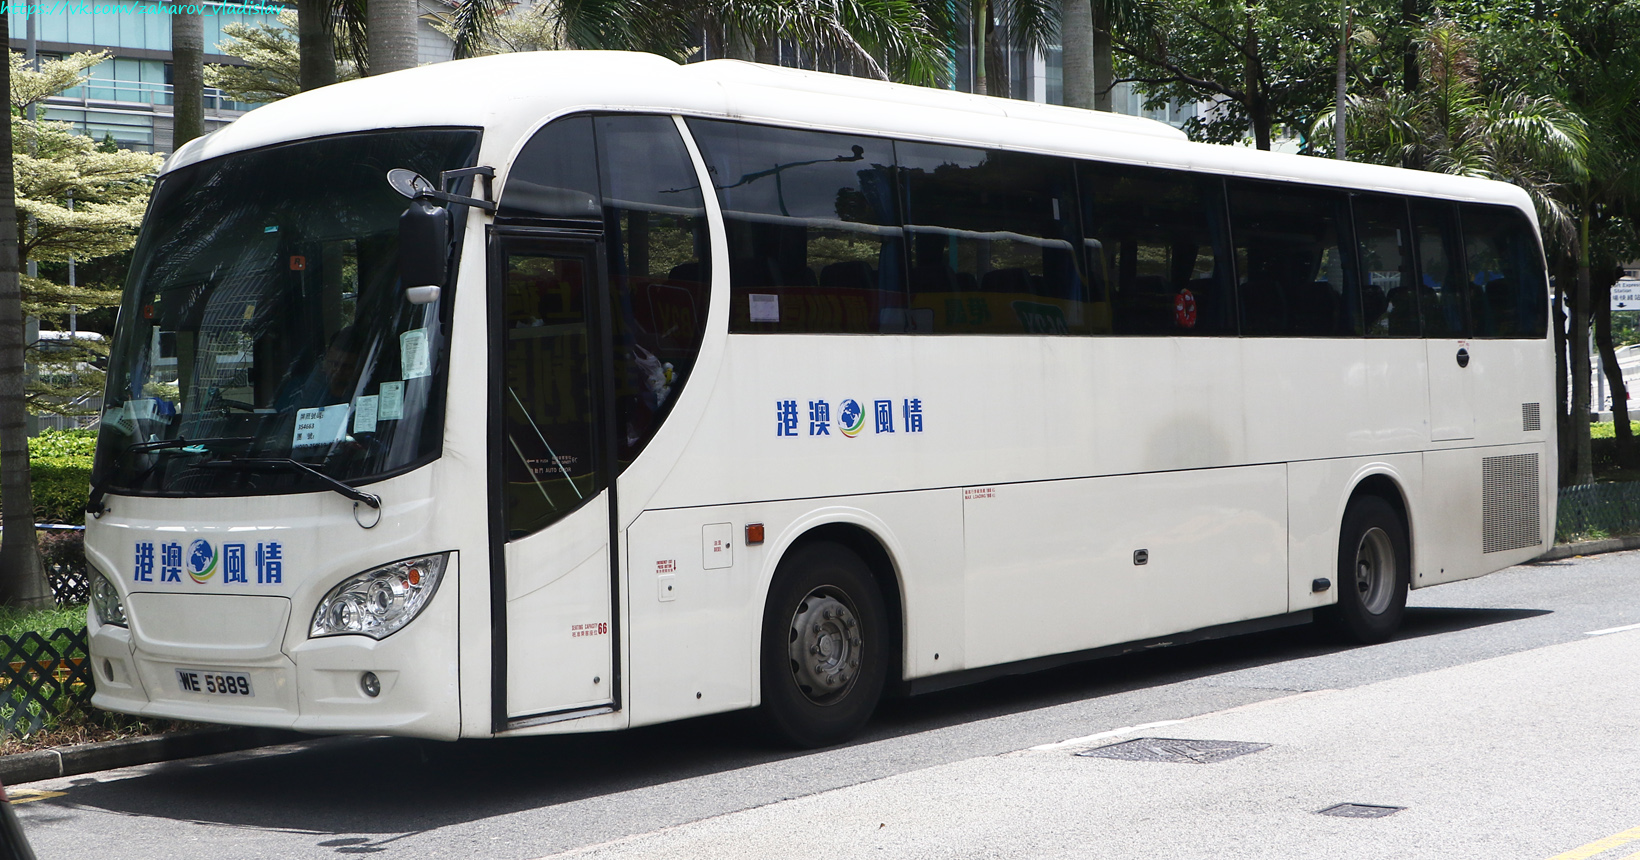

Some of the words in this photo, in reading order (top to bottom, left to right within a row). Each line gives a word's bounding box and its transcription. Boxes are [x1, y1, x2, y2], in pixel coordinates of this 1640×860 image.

[598, 622, 607, 635] 66
[179, 672, 201, 692] WE
[204, 674, 250, 695] 5889
